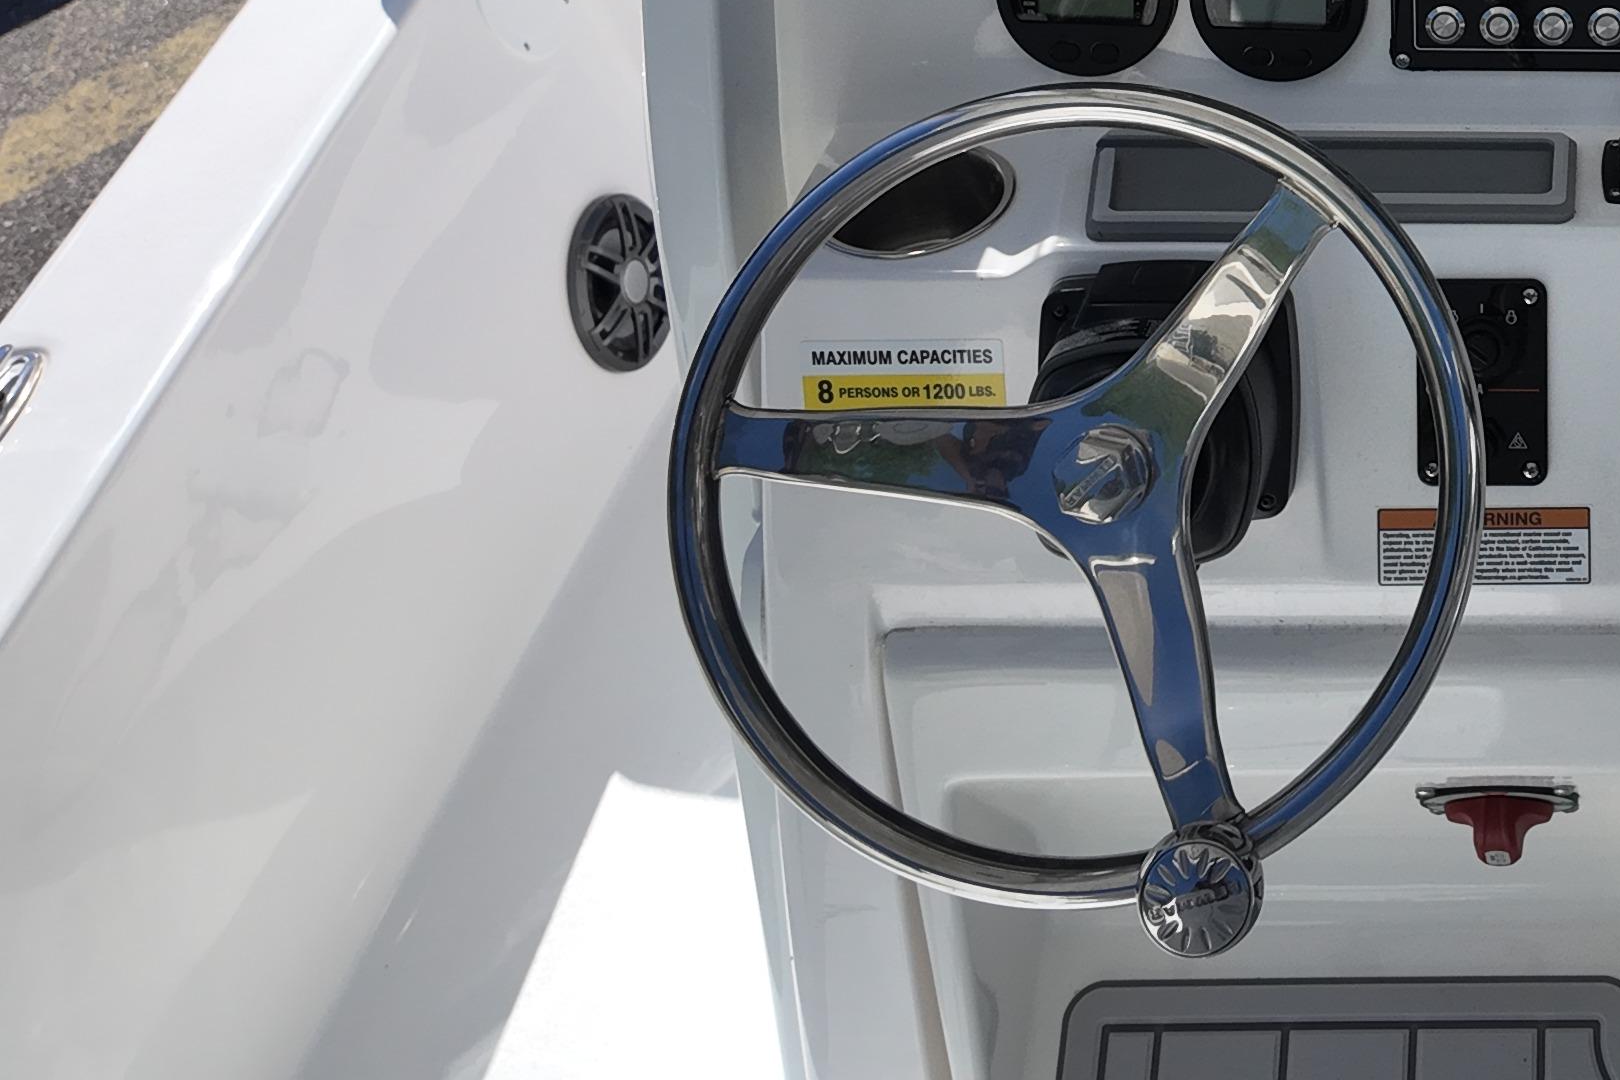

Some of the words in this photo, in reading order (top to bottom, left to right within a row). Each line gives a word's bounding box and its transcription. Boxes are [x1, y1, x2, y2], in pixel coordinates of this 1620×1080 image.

[812, 350, 892, 366] MAXIMUM
[897, 348, 994, 364] CAPACITIES
[818, 380, 834, 404] 8
[839, 386, 899, 398] PERSONS
[902, 386, 920, 398] OR
[923, 384, 965, 400] 1200
[968, 386, 996, 397] LBS.
[1484, 512, 1542, 526] RNING
